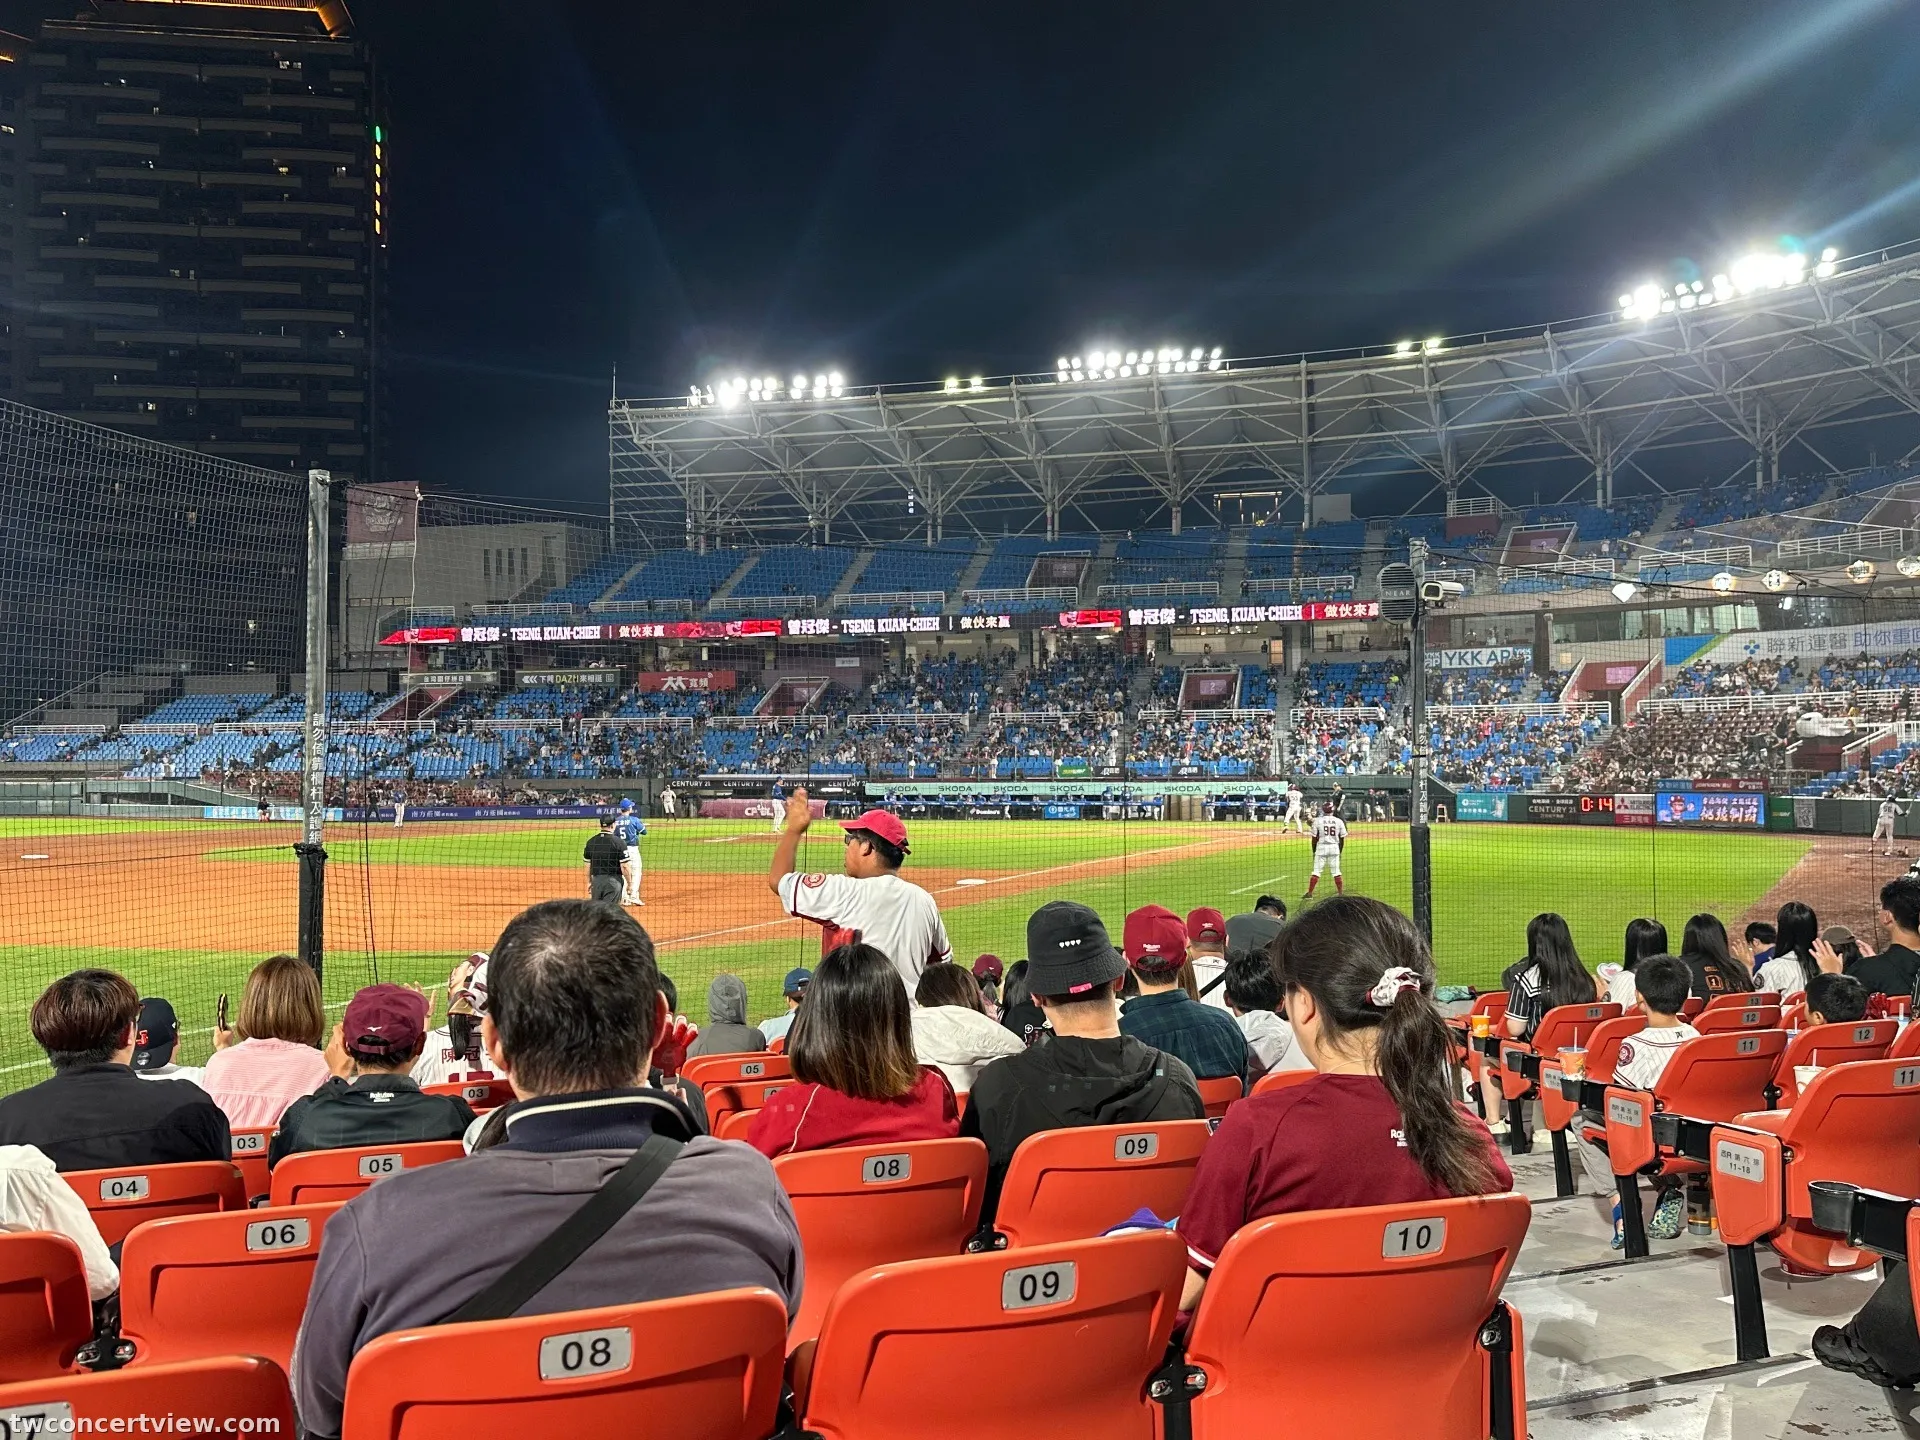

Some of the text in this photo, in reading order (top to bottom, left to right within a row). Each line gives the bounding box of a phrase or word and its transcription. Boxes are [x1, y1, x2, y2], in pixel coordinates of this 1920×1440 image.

[1190, 608, 1230, 624] TSENG,
[1231, 605, 1303, 622] KUAN-CHIEH
[841, 618, 875, 634] TSENG,
[878, 616, 940, 632] KUAN-CHIEH
[510, 627, 542, 641] TSENG,
[543, 625, 601, 640] KUAN-CHIEH
[1767, 633, 1848, 654] 聯新運醫
[1444, 649, 1512, 666] YKK AP
[1528, 806, 1576, 814] CENTURY 21
[620, 827, 627, 839] 5
[1323, 826, 1336, 836] 96
[1589, 1008, 1600, 1016] 11
[1746, 1013, 1756, 1022] 12
[1858, 1029, 1871, 1041] 12
[1741, 1040, 1754, 1052] 11
[745, 1065, 759, 1075] 05
[1901, 1069, 1914, 1084] 11
[468, 1088, 484, 1098] 03
[236, 1137, 257, 1149] 03
[1124, 1138, 1148, 1155] 09
[369, 1158, 393, 1173] 05
[873, 1159, 899, 1177] 08
[1729, 1162, 1751, 1174] 11-18
[112, 1180, 138, 1196] 04
[261, 1224, 295, 1246] 06
[1398, 1224, 1431, 1251] 10
[1019, 1270, 1060, 1302] 09
[561, 1337, 612, 1372] 08
